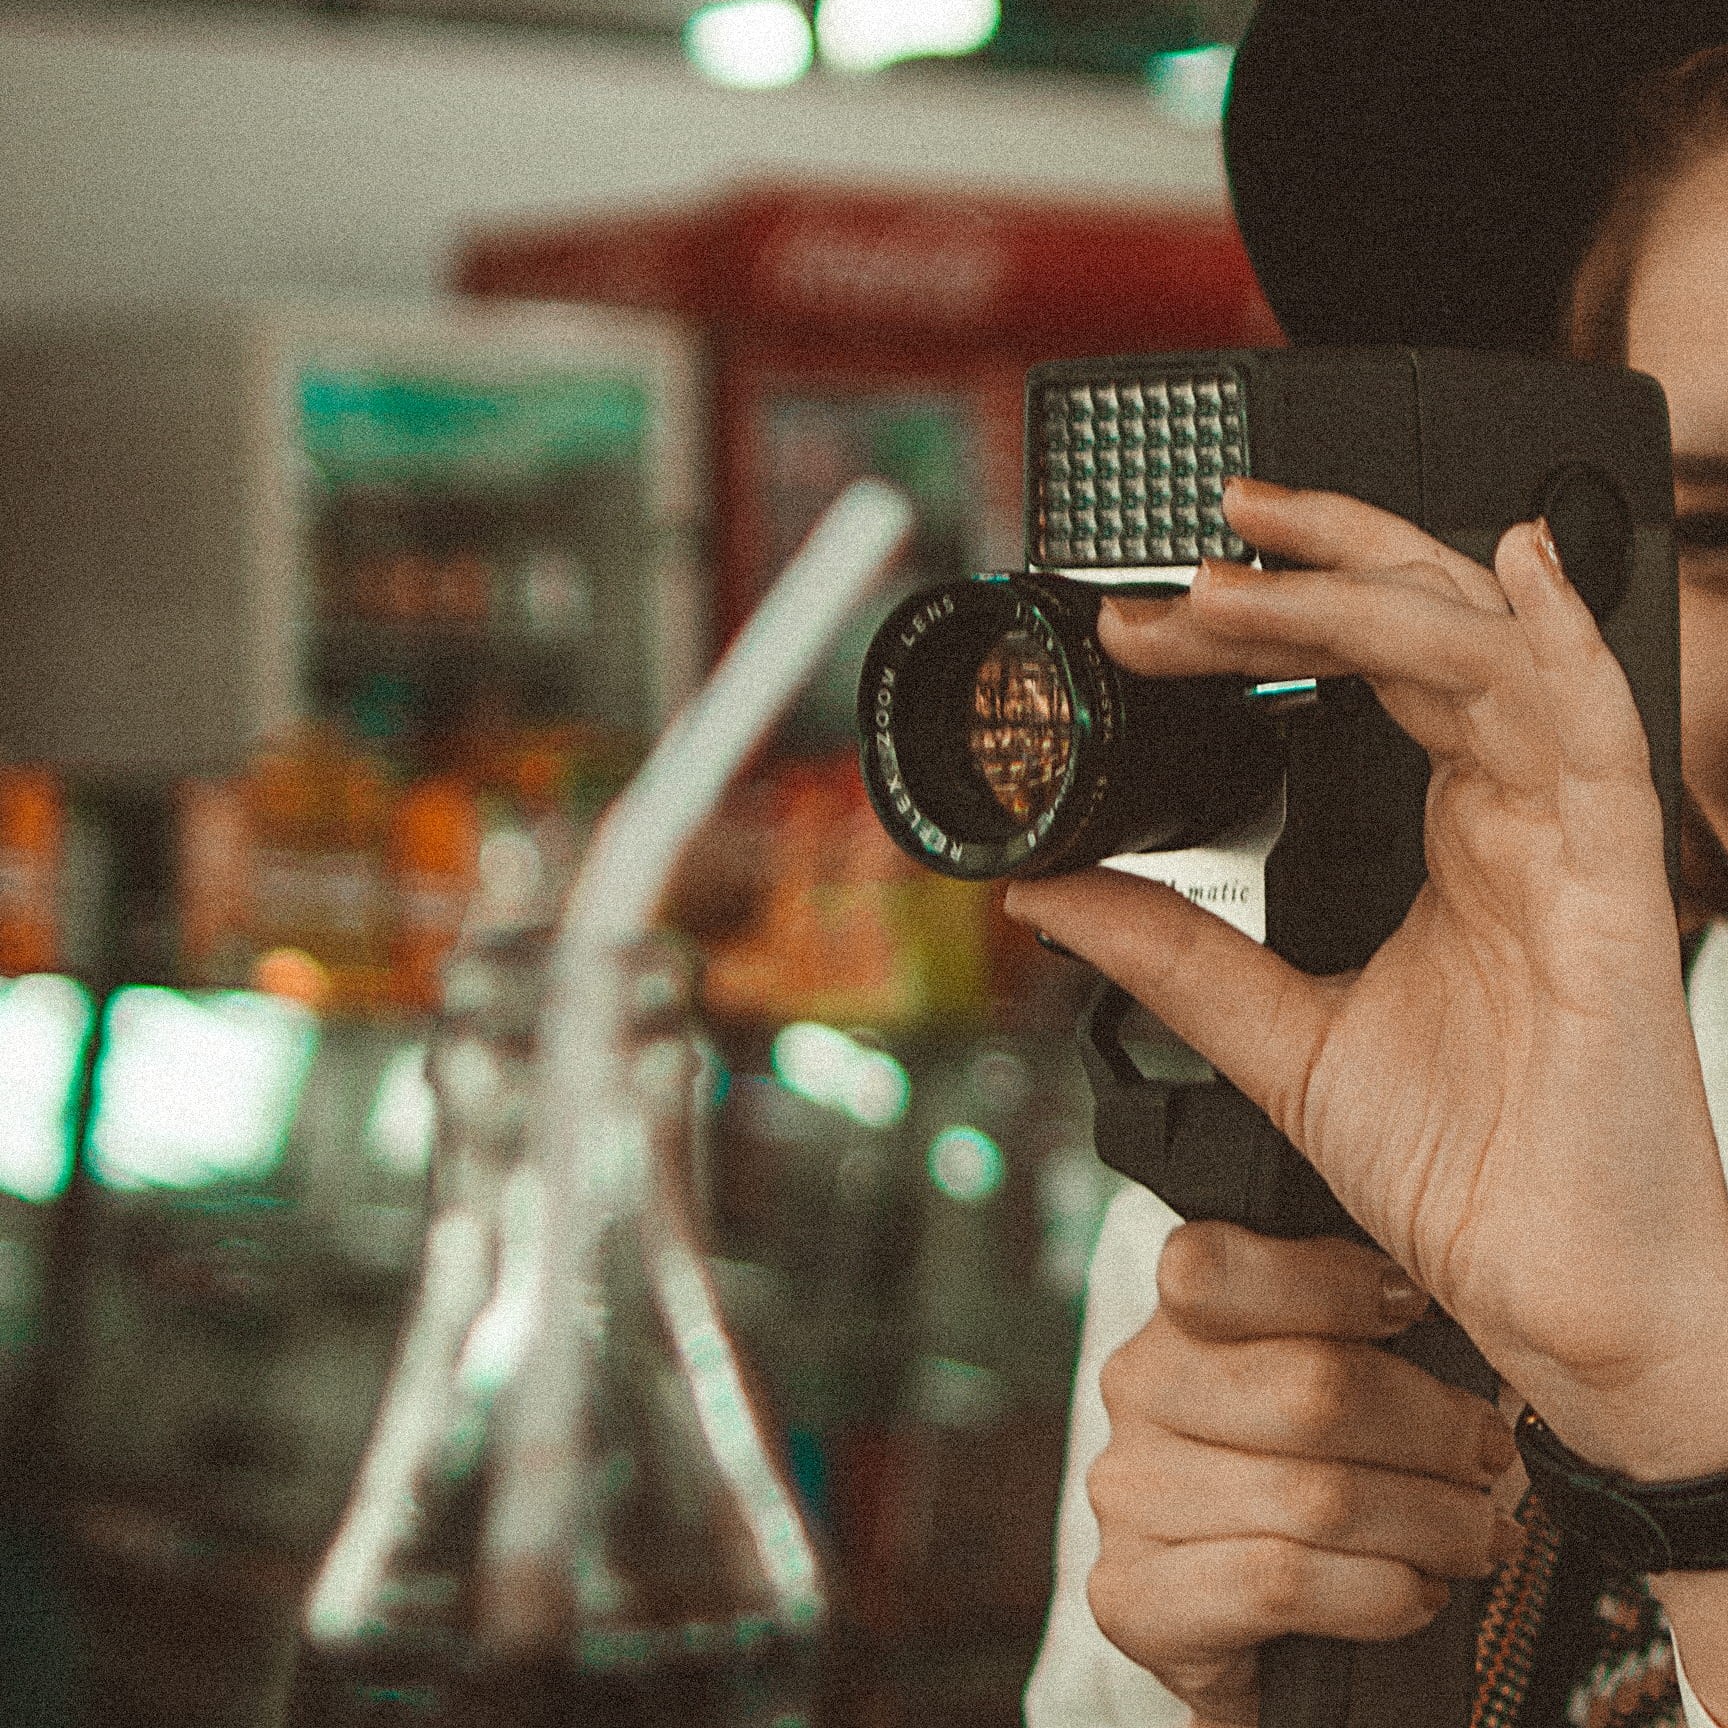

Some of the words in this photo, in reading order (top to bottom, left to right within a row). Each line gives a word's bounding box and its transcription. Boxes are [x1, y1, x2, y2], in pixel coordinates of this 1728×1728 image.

[900, 593, 955, 647] LENS
[875, 666, 896, 750] ZOOM
[885, 773, 964, 863] REFLEX
[1168, 880, 1250, 904] matic
